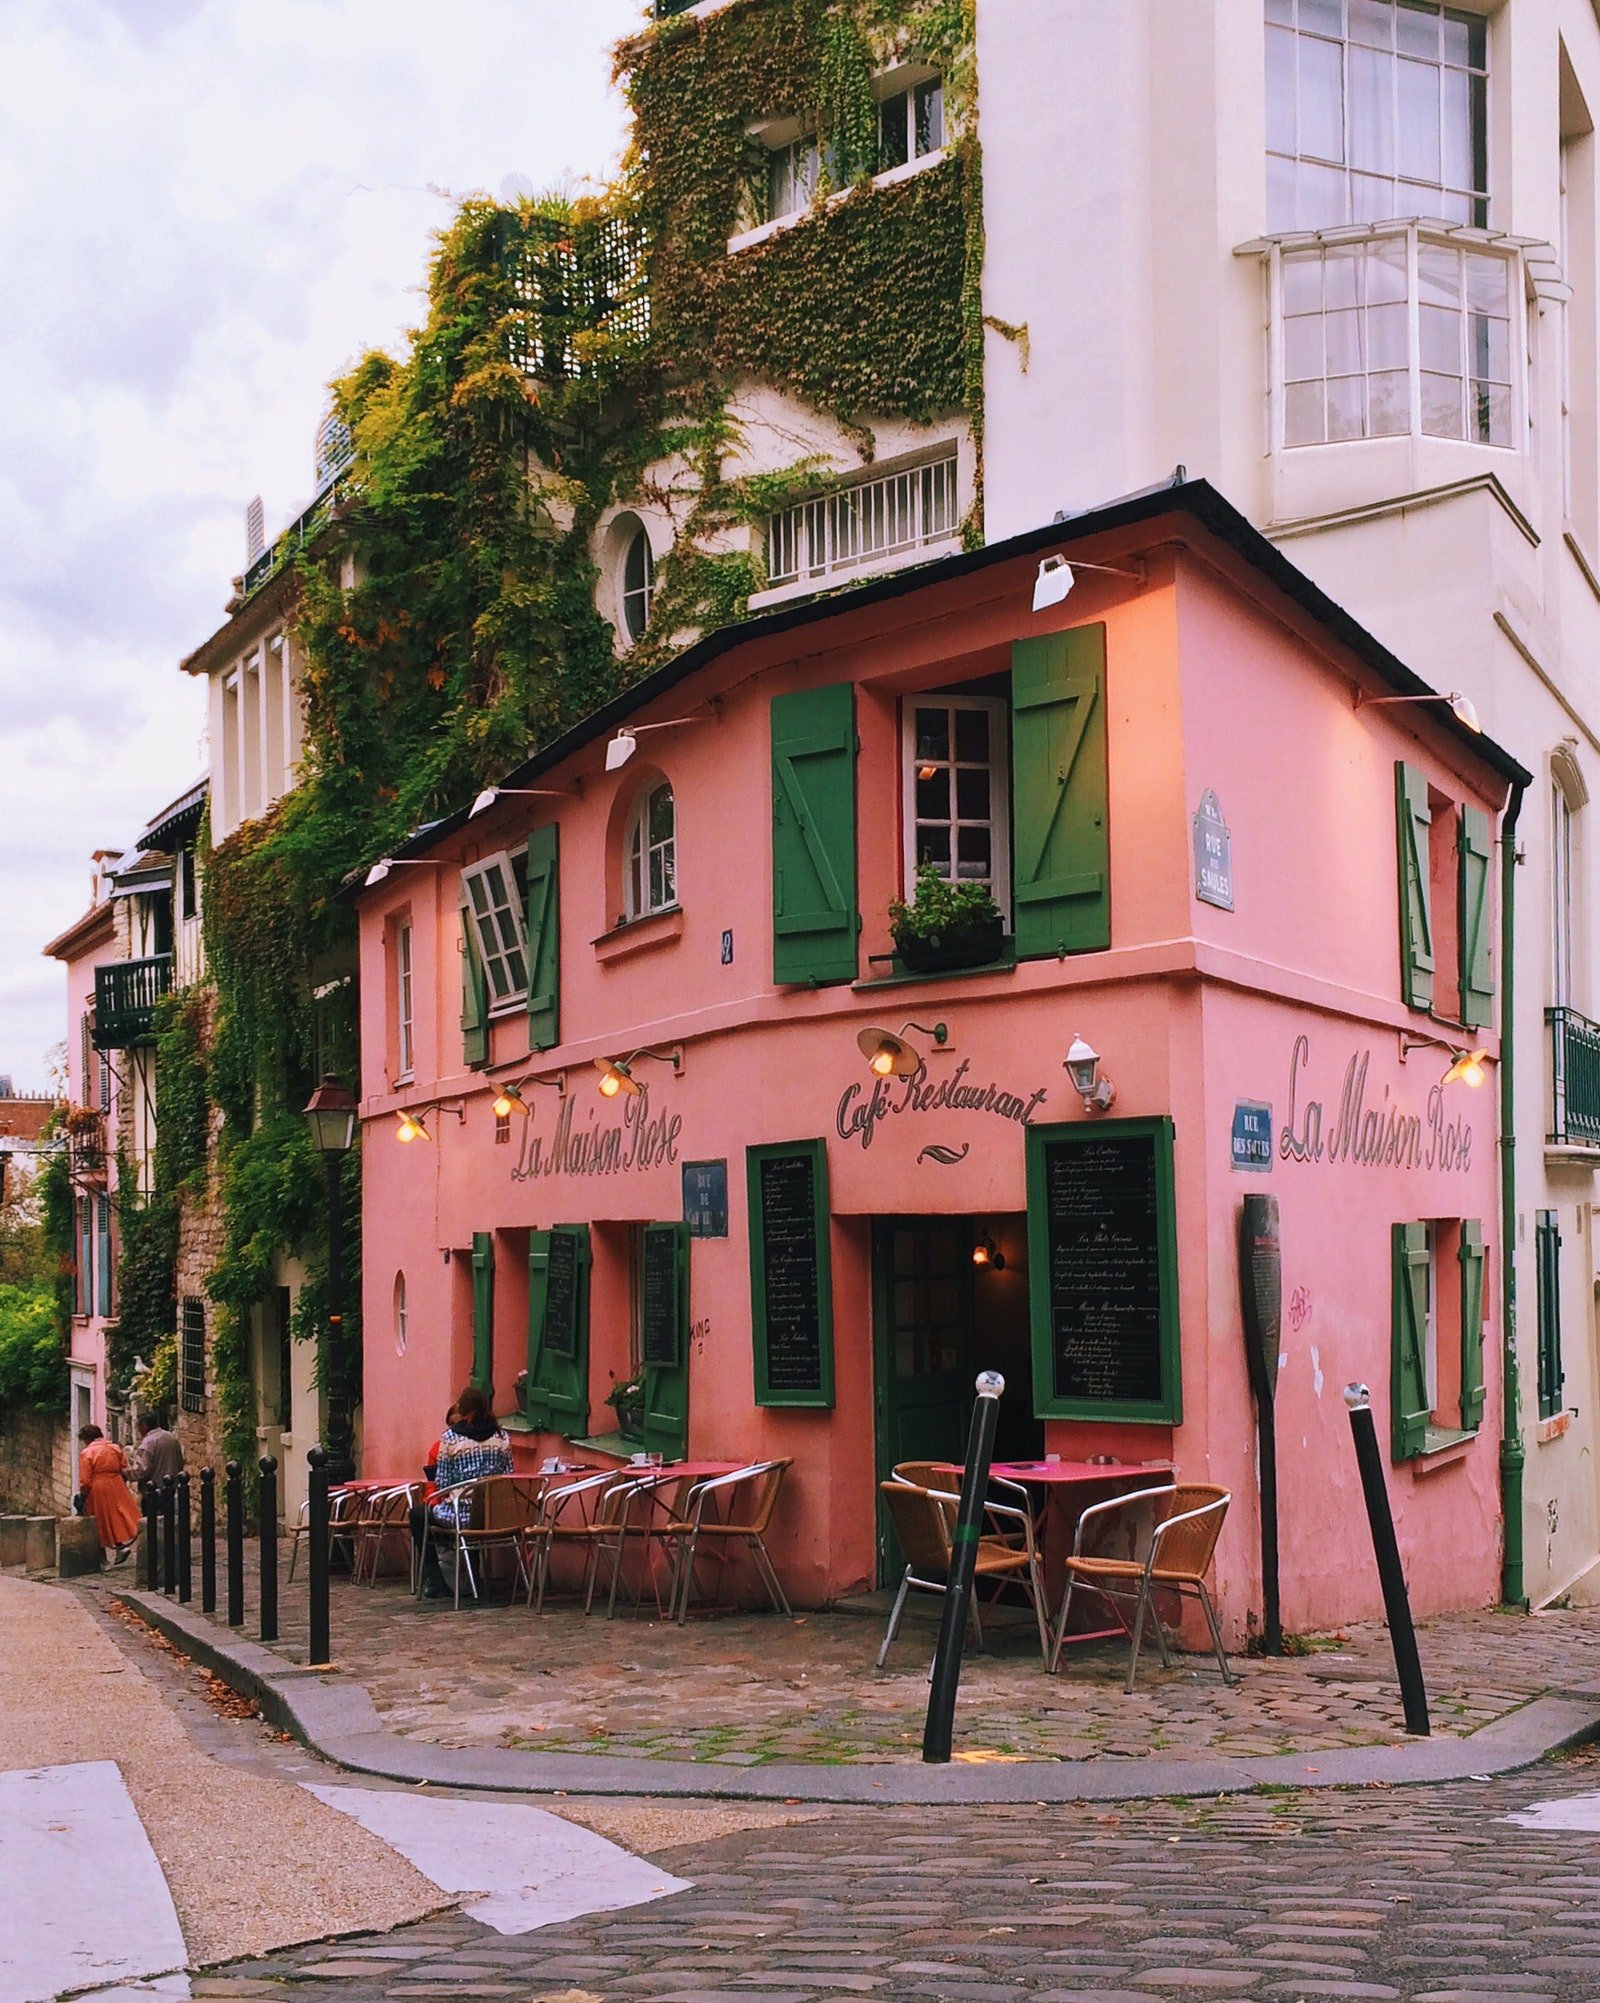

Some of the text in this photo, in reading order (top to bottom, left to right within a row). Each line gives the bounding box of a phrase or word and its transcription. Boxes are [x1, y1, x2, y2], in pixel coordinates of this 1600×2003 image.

[1205, 832, 1222, 857] RUE
[1201, 868, 1230, 896] SAULES
[836, 1057, 1048, 1149] Café Restaurant
[1279, 1034, 1472, 1173] La Maison Rose
[511, 1082, 682, 1182] La Maison Rose
[1243, 1114, 1260, 1132] RUE
[1233, 1136, 1246, 1154] DES
